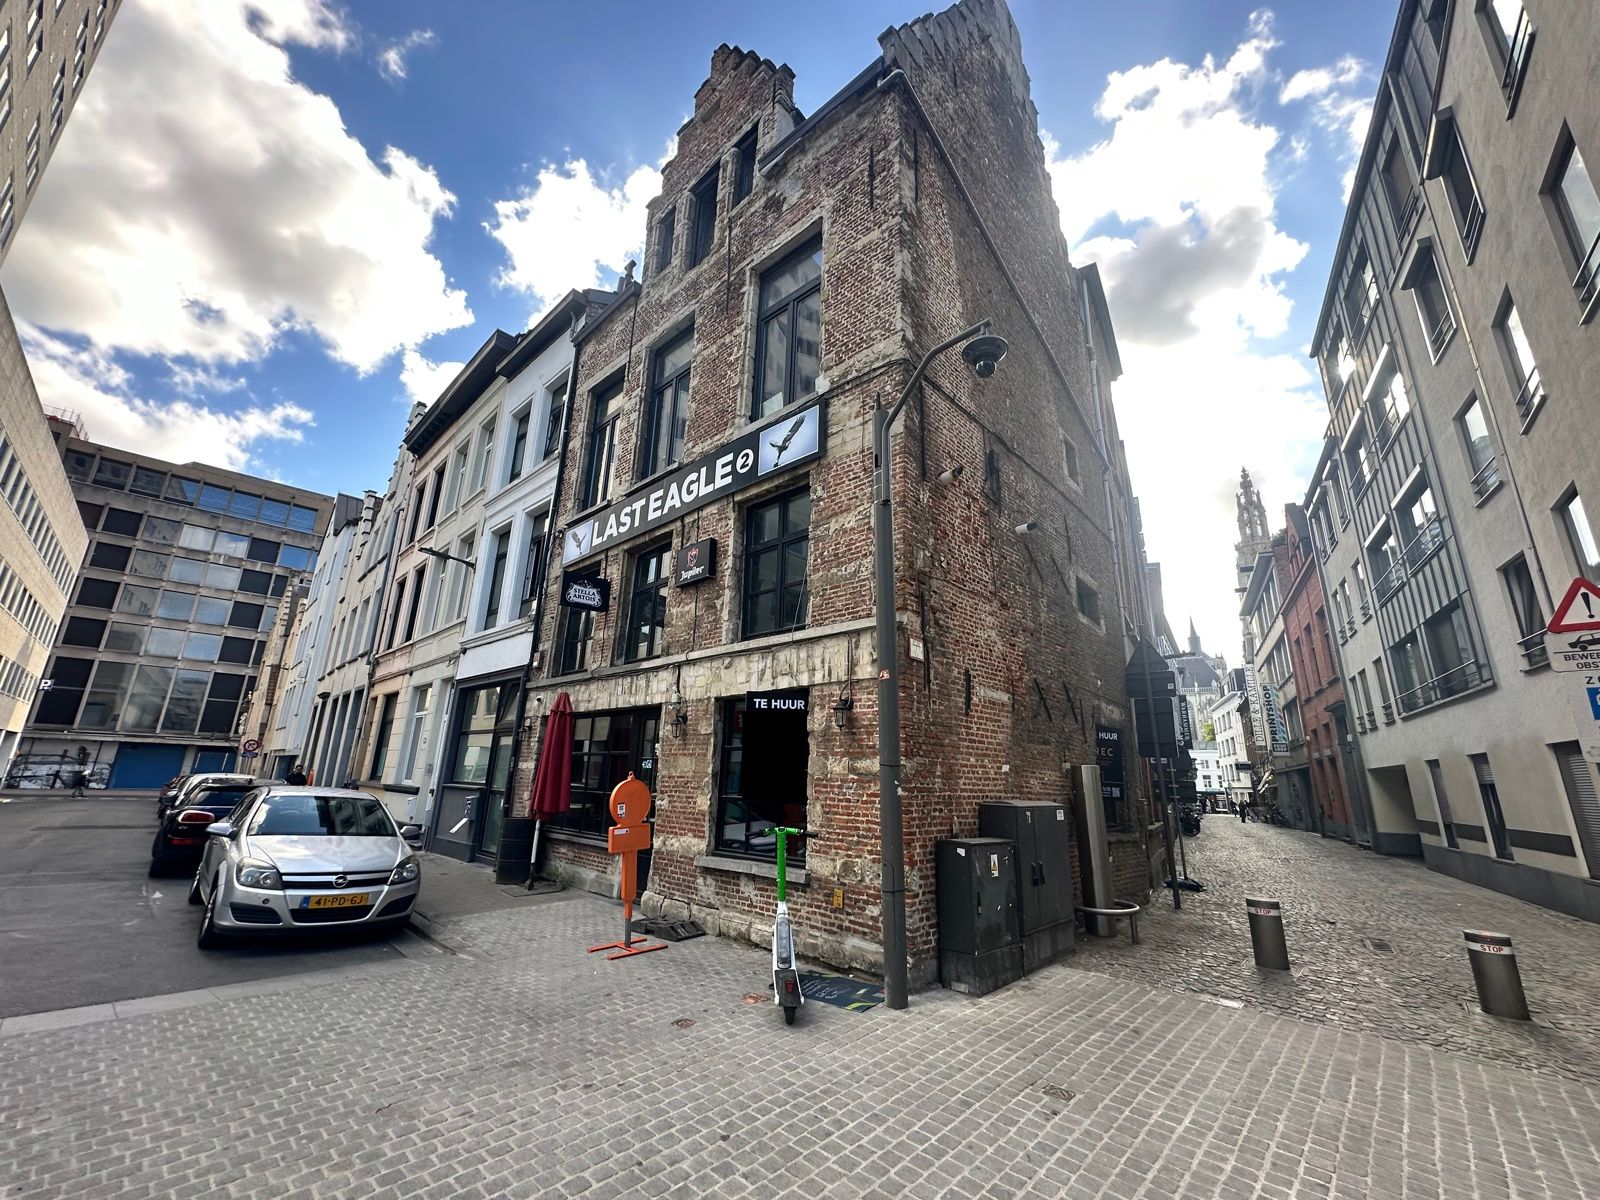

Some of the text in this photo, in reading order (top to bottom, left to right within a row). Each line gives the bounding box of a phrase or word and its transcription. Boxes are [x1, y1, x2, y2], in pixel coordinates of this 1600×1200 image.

[592, 497, 646, 547] LAST
[648, 452, 734, 521] EAGLE
[573, 587, 596, 597] STELLA
[573, 593, 596, 602] ARTOIS
[1247, 664, 1259, 706] KAMILLE
[753, 698, 805, 710] TE HUUR
[1262, 685, 1279, 743] PRINTSHOP
[1098, 731, 1118, 740] HUUR
[1253, 717, 1265, 744] DILLE
[1480, 944, 1504, 953] STOP
